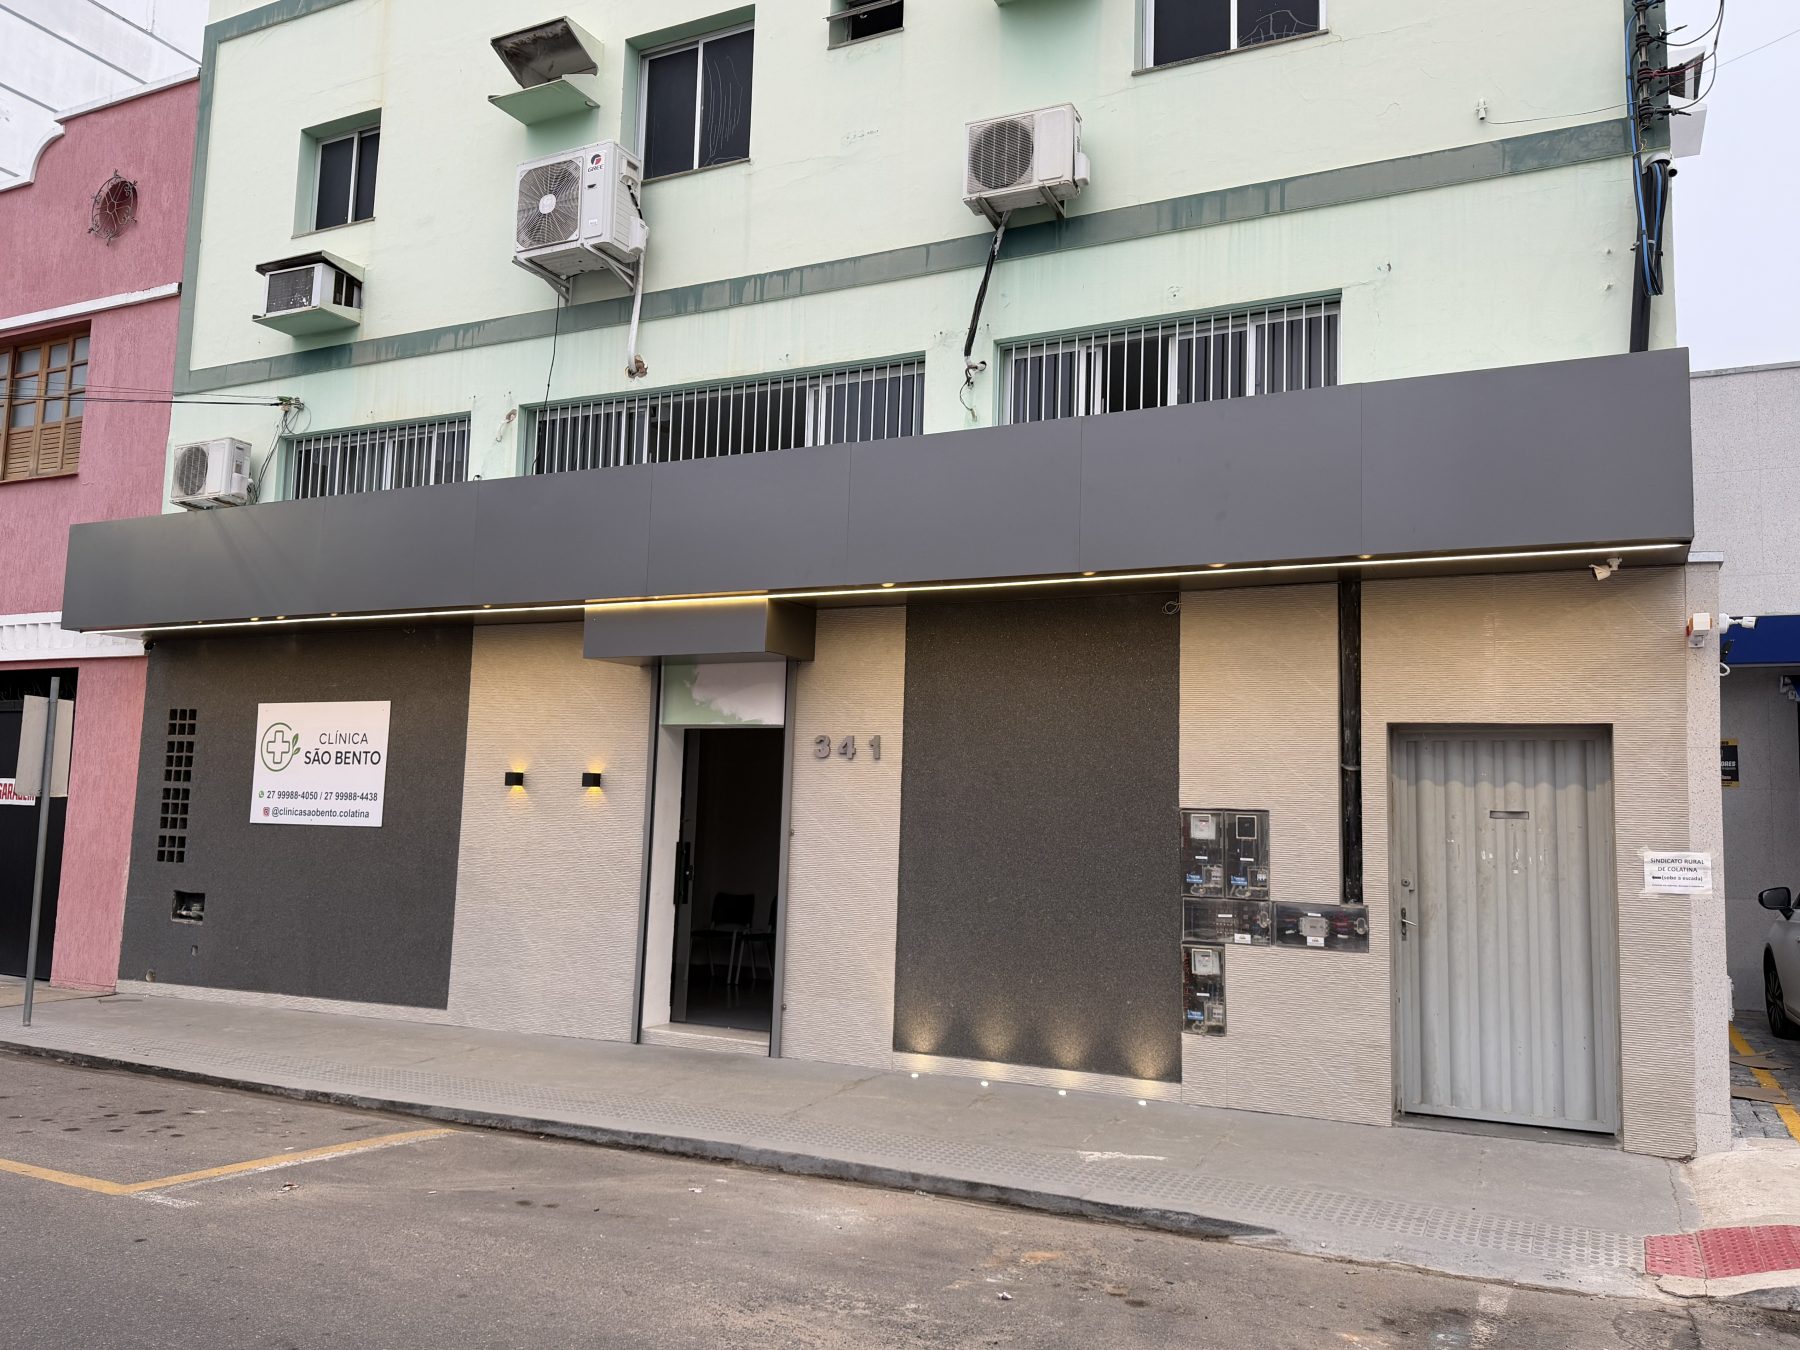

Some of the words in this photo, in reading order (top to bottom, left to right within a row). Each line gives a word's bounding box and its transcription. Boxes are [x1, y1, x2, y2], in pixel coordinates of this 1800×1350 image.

[319, 730, 368, 745] CLÍNICA
[814, 735, 881, 760] 341
[304, 748, 331, 765] SÃO
[335, 751, 381, 766] BENTO
[267, 790, 275, 799] 27
[277, 791, 318, 800] 99988-4050
[325, 792, 333, 800] 27
[335, 792, 378, 801] 99988-4438
[271, 807, 370, 818] @clinicasaobento.colatina
